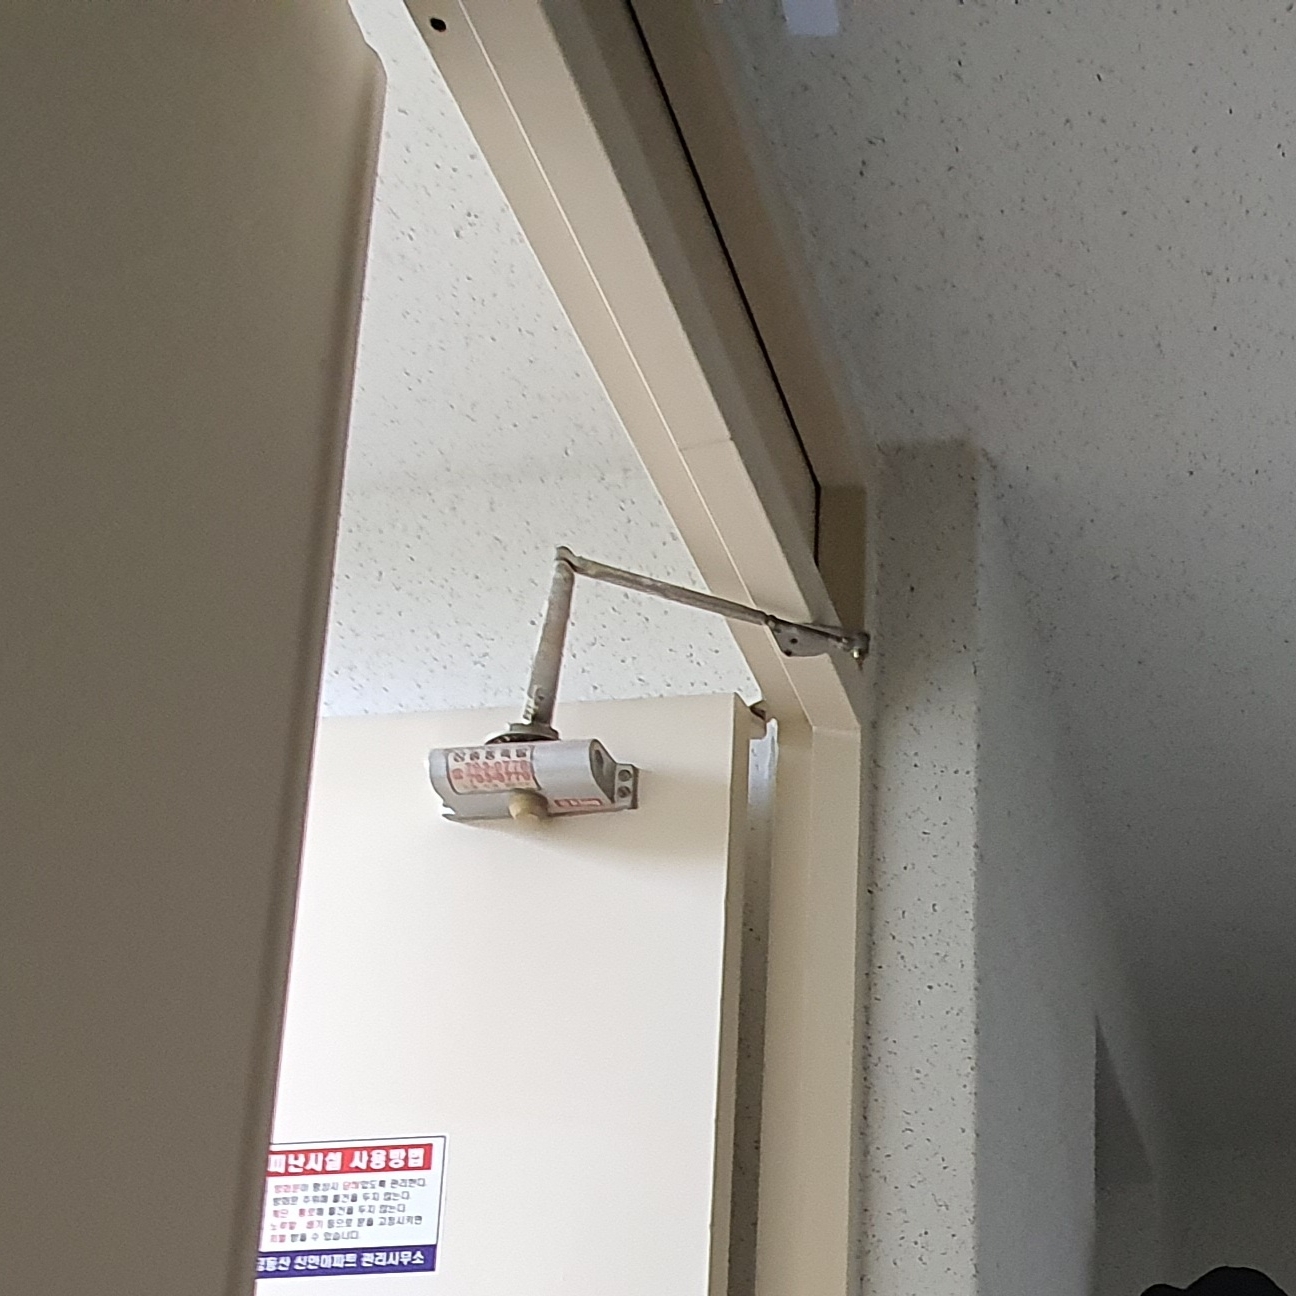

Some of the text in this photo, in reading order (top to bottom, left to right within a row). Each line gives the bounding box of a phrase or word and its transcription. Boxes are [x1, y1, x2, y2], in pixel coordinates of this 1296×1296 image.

[267, 1147, 425, 1174] 피난시설 사용방법
[294, 1253, 358, 1270] 신안아파트
[361, 1250, 425, 1267] 관리사무소
